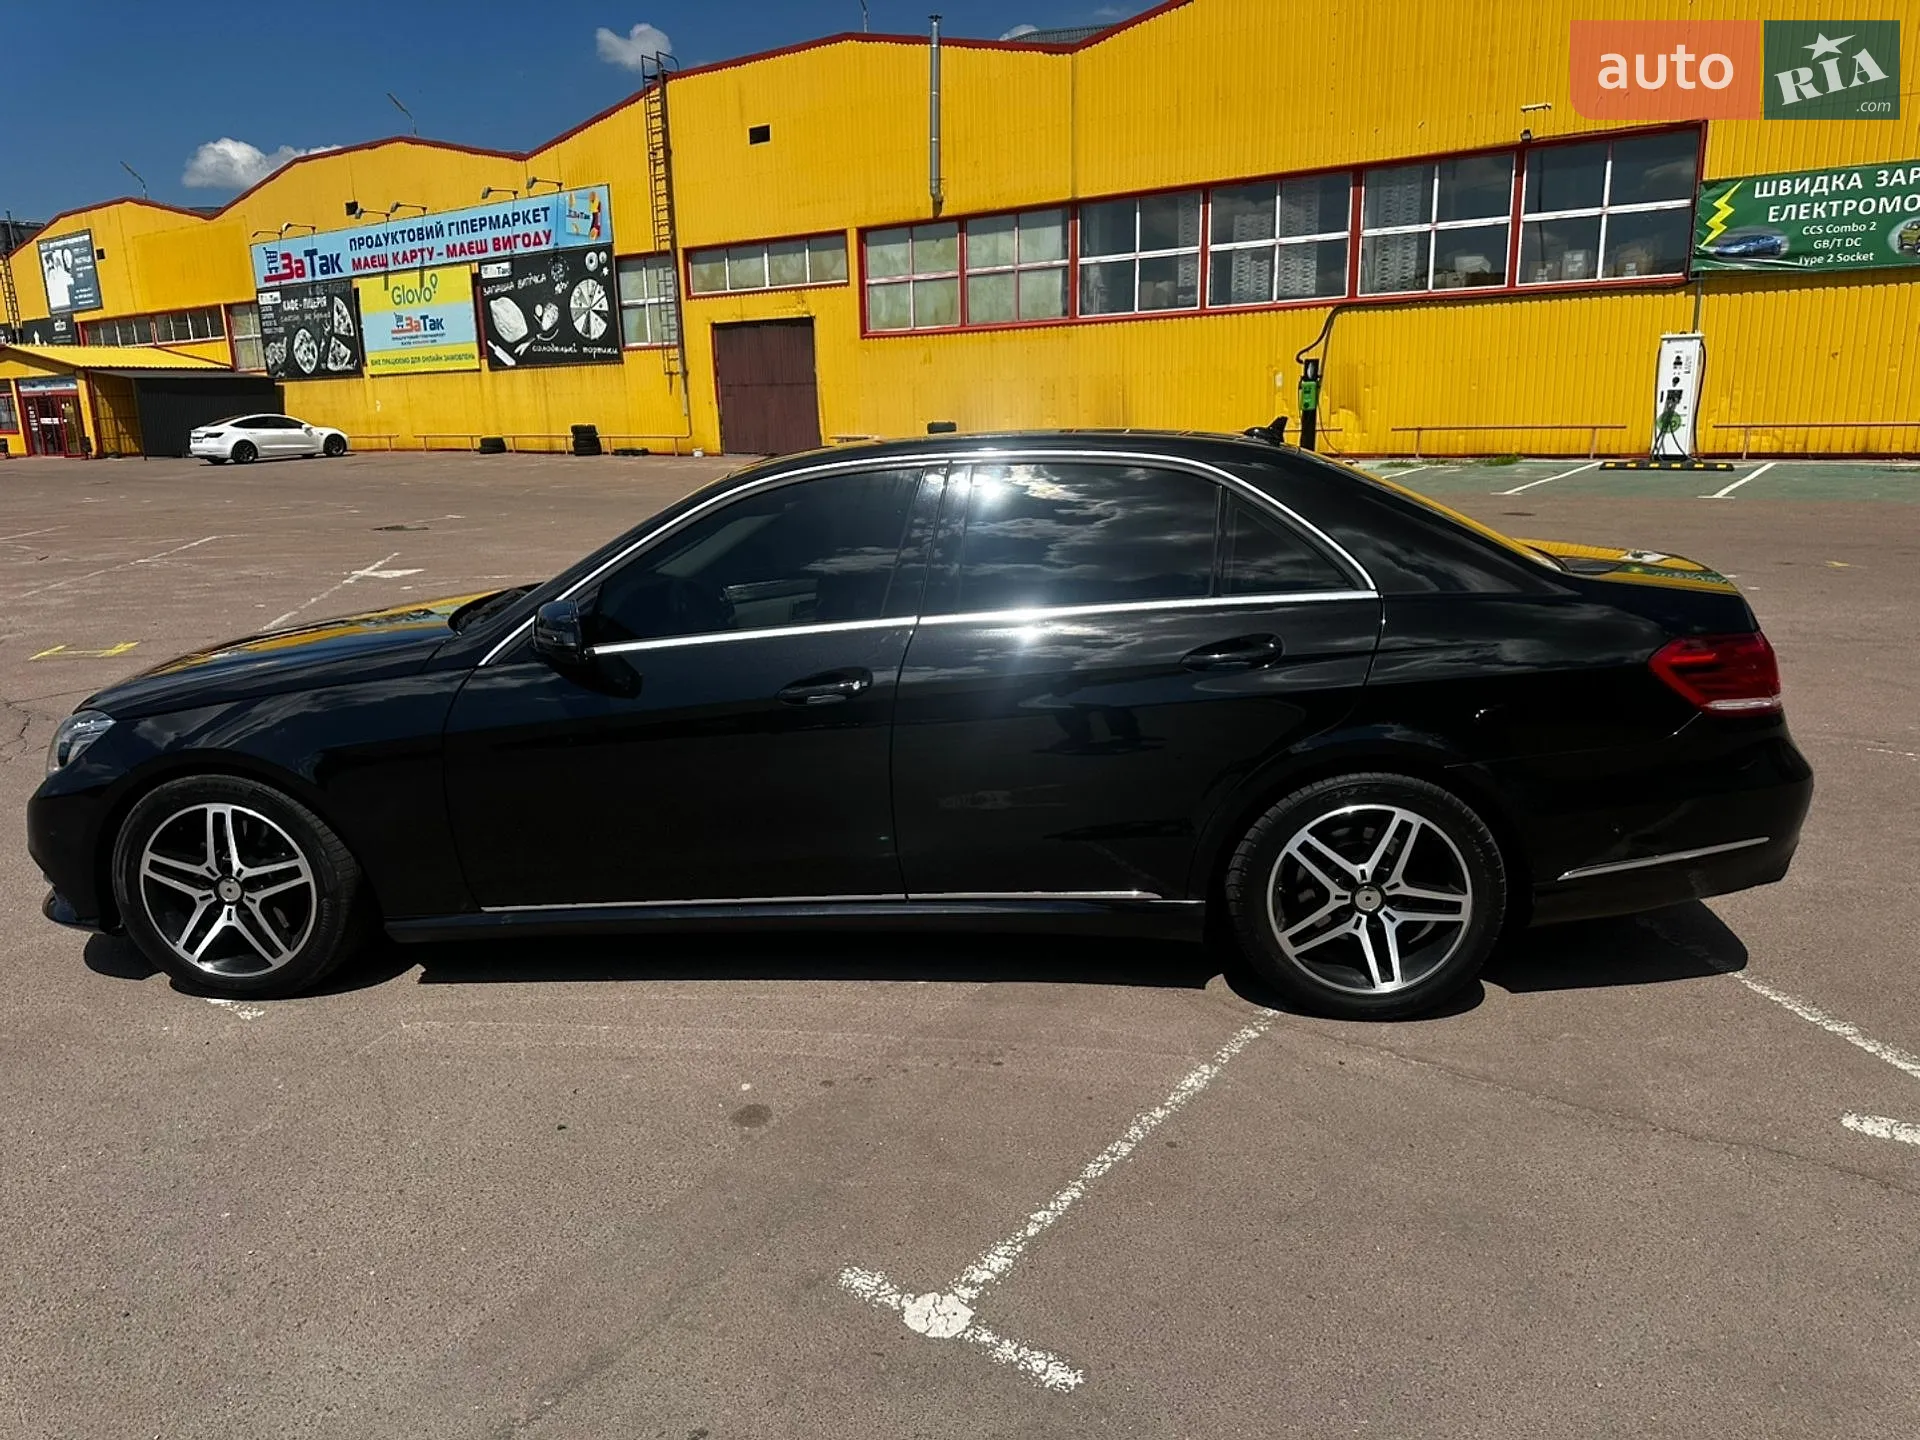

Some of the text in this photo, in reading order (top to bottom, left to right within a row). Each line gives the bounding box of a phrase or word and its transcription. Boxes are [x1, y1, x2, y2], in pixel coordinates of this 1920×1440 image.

[1754, 167, 1920, 198] ШВИДКА ЗАР
[1767, 194, 1920, 222] ЕЛЕКТРОМО
[349, 207, 551, 251] ПРОДУКТОВИЙ ГІПЕРМАРКЕТ
[1802, 221, 1877, 236] CCS Combo 2
[351, 253, 388, 272] МАЄШ
[392, 246, 434, 266] КАРТУ
[446, 239, 488, 258] МАЄШ
[492, 229, 553, 252] ВИГОДУ
[1813, 237, 1862, 250] GB/T DC
[1798, 251, 1875, 266] Type 2 Socket
